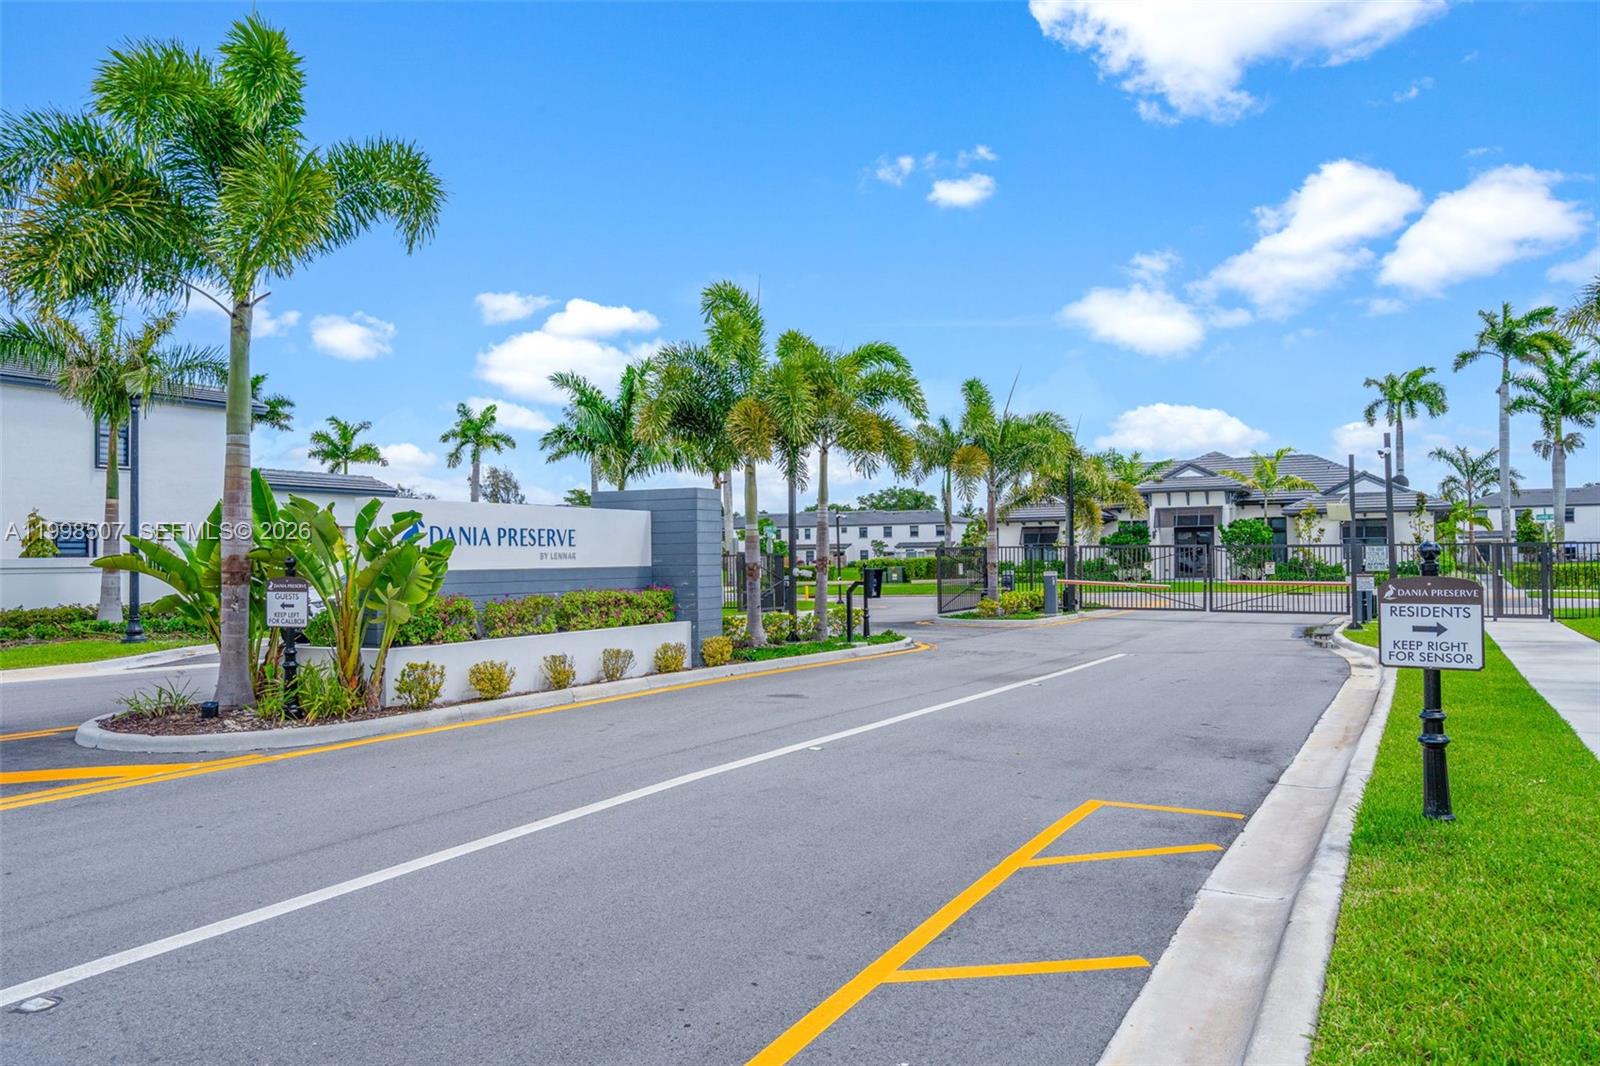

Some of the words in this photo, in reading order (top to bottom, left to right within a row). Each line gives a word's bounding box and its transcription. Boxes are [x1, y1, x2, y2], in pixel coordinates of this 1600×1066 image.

[429, 525, 491, 546] DANIA
[497, 527, 576, 547] PRESERVE
[540, 552, 550, 560] BY
[550, 552, 577, 561] LENNAR
[1397, 588, 1428, 597] DANIA
[1431, 589, 1479, 598] PRESERVE
[1389, 605, 1471, 618] RESIDENTS
[1393, 640, 1423, 650] KEEP
[1427, 641, 1468, 652] RIGHT
[1388, 651, 1415, 661] FOR
[1419, 652, 1474, 664] SENSOR
